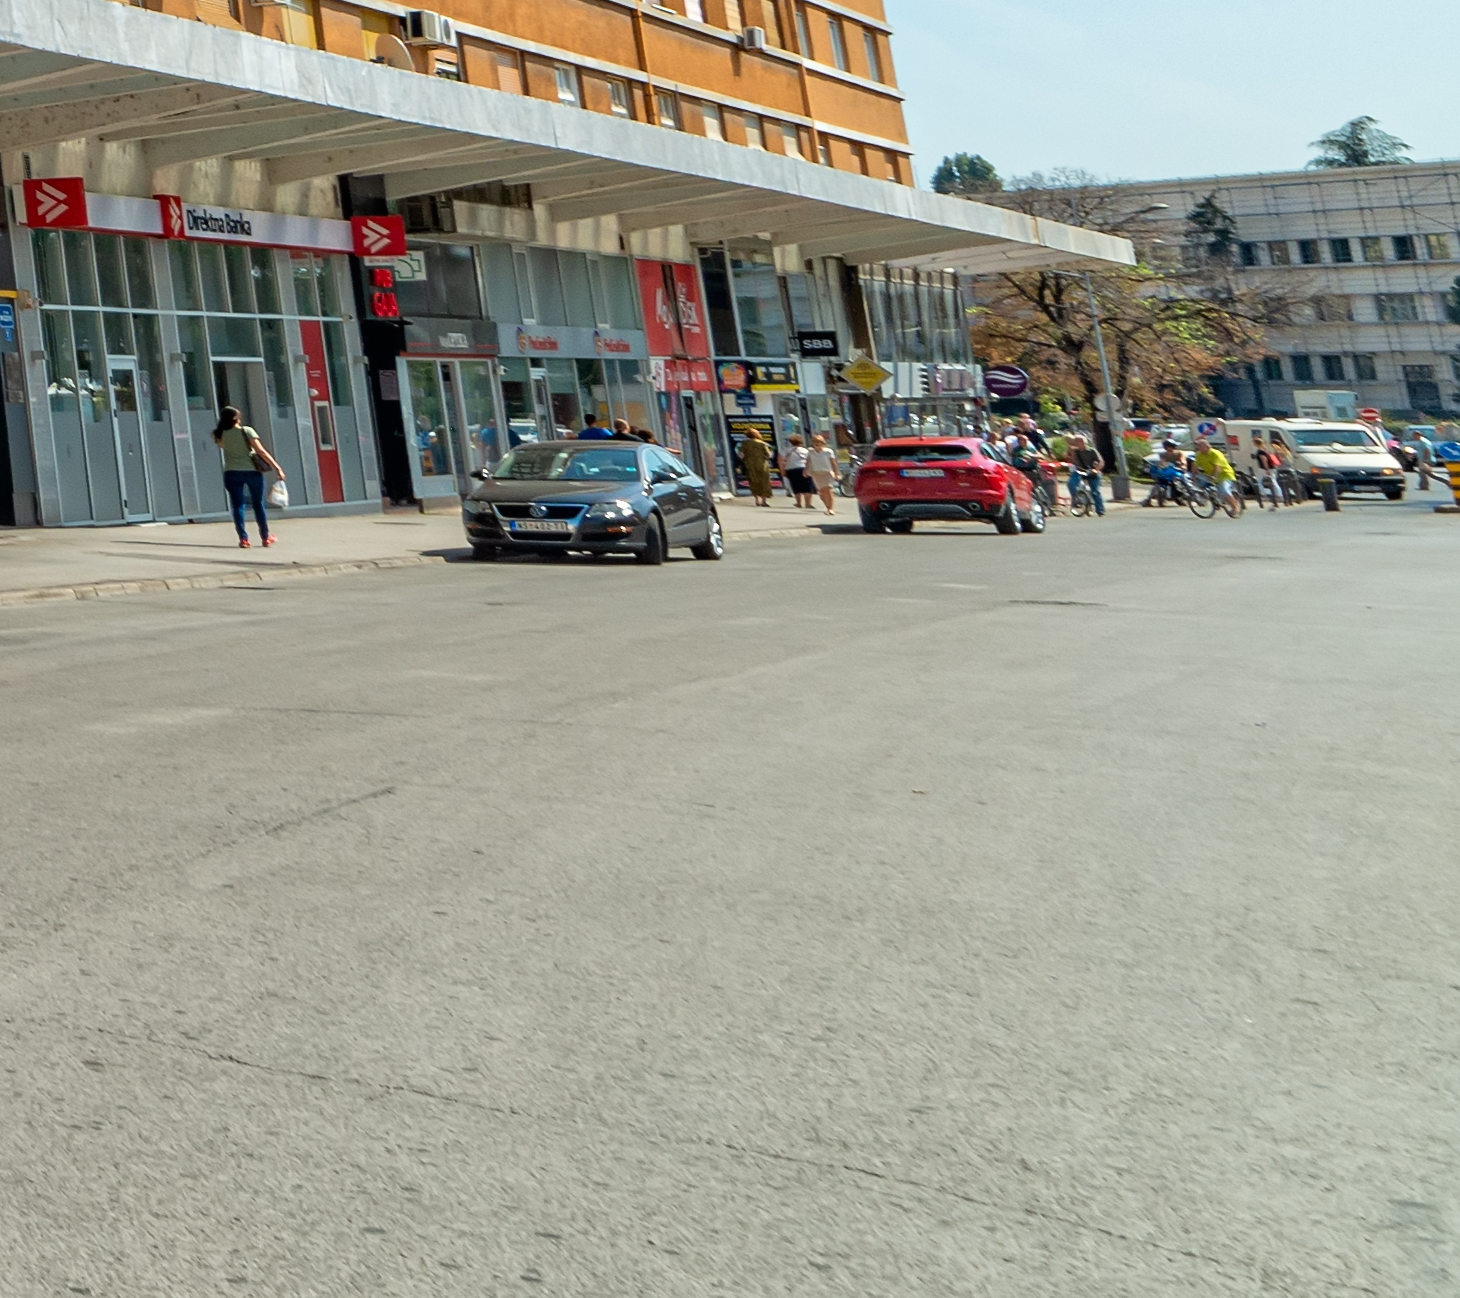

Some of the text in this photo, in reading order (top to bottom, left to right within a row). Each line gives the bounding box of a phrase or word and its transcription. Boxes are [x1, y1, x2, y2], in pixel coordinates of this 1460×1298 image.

[186, 208, 253, 236] Direktna Banka
[802, 339, 835, 350] SBB
